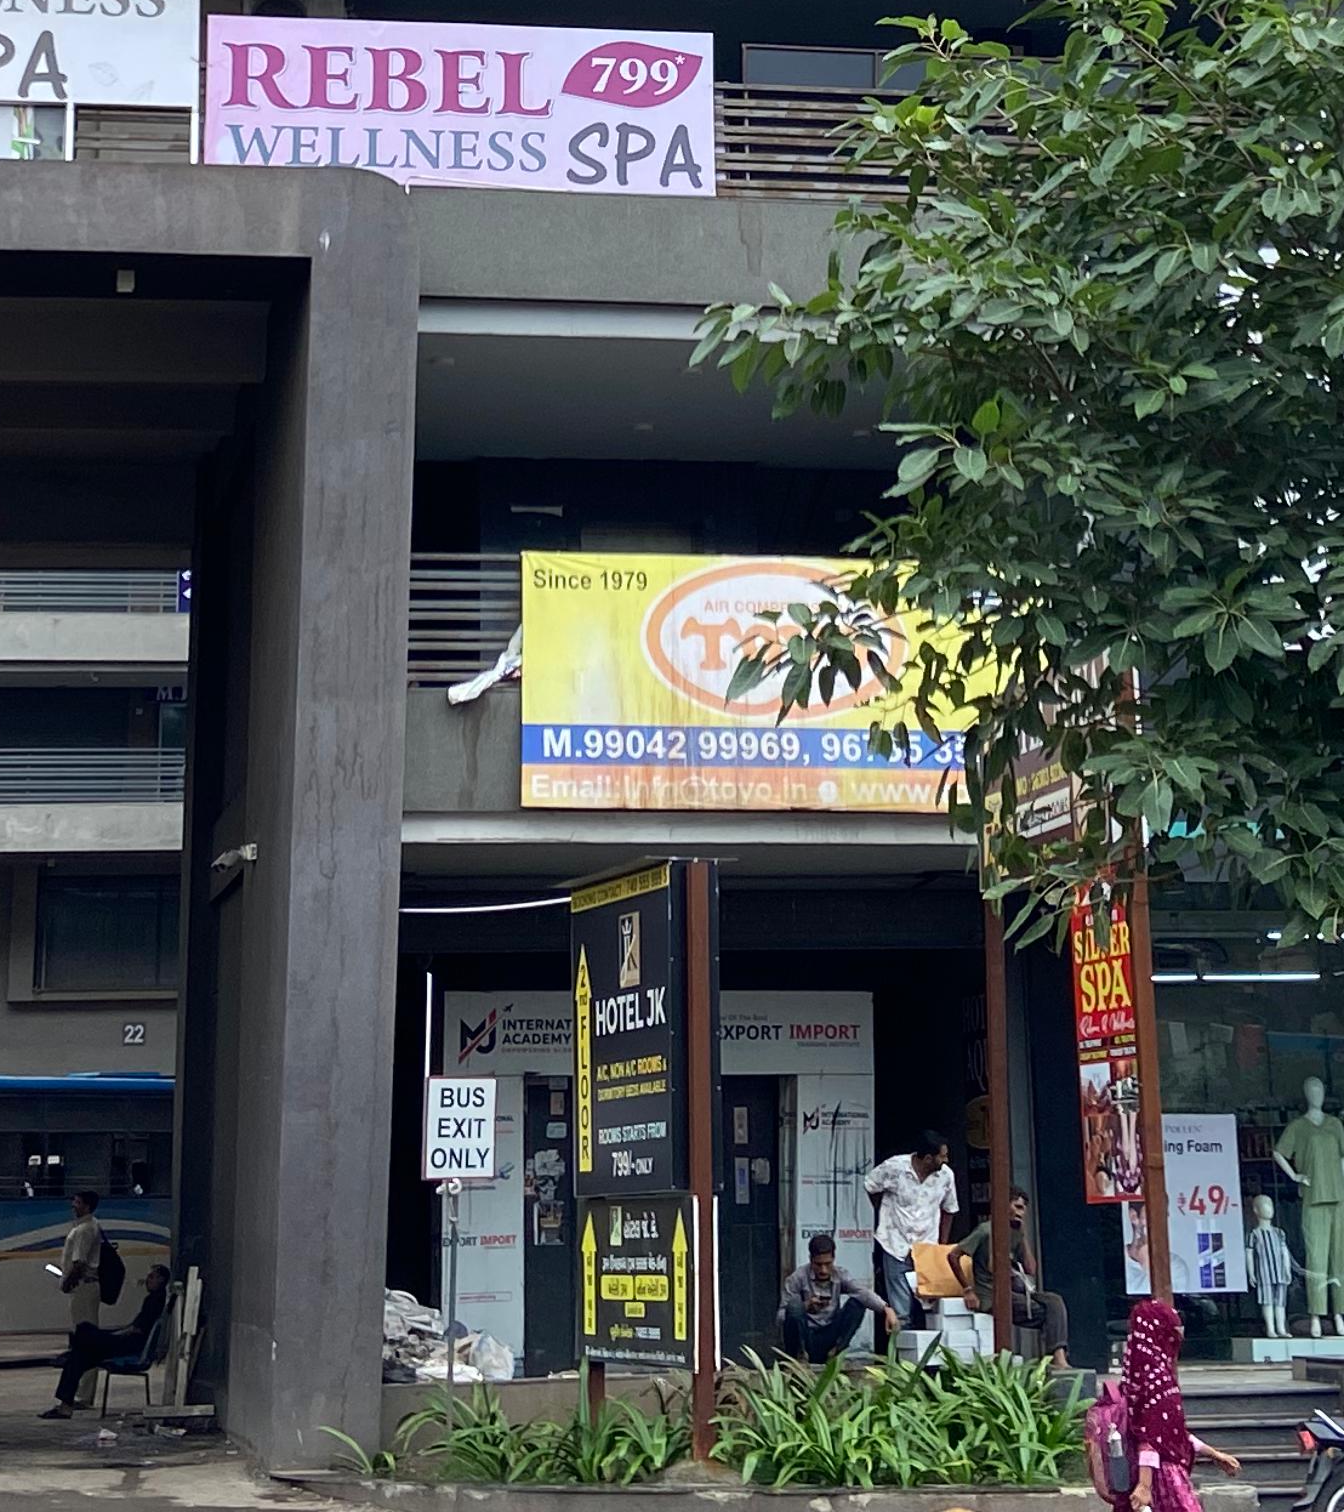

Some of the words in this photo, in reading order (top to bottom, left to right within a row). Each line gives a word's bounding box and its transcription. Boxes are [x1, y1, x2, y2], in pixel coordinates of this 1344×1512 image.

[221, 40, 554, 118] REBEL
[224, 123, 548, 174] WELLNESS
[566, 121, 703, 188] SPA
[533, 569, 592, 590] Since
[598, 569, 648, 592] 1979
[704, 600, 731, 614] AIR
[698, 731, 811, 766] 99969,
[1074, 921, 1131, 964] SILER
[1080, 959, 1132, 1013] SPA
[595, 992, 644, 1037] HOTEL
[646, 987, 667, 1028] JK
[123, 1024, 145, 1044] 22
[502, 1033, 572, 1045] ACADEMY
[789, 1024, 861, 1040] IMPORT
[637, 1055, 662, 1075] ROOMS
[440, 1087, 485, 1108] BUS
[437, 1118, 487, 1139] EXIT
[1187, 1139, 1223, 1153] Foam
[430, 1148, 490, 1170] ONLY
[480, 1235, 517, 1246] IMPORT
